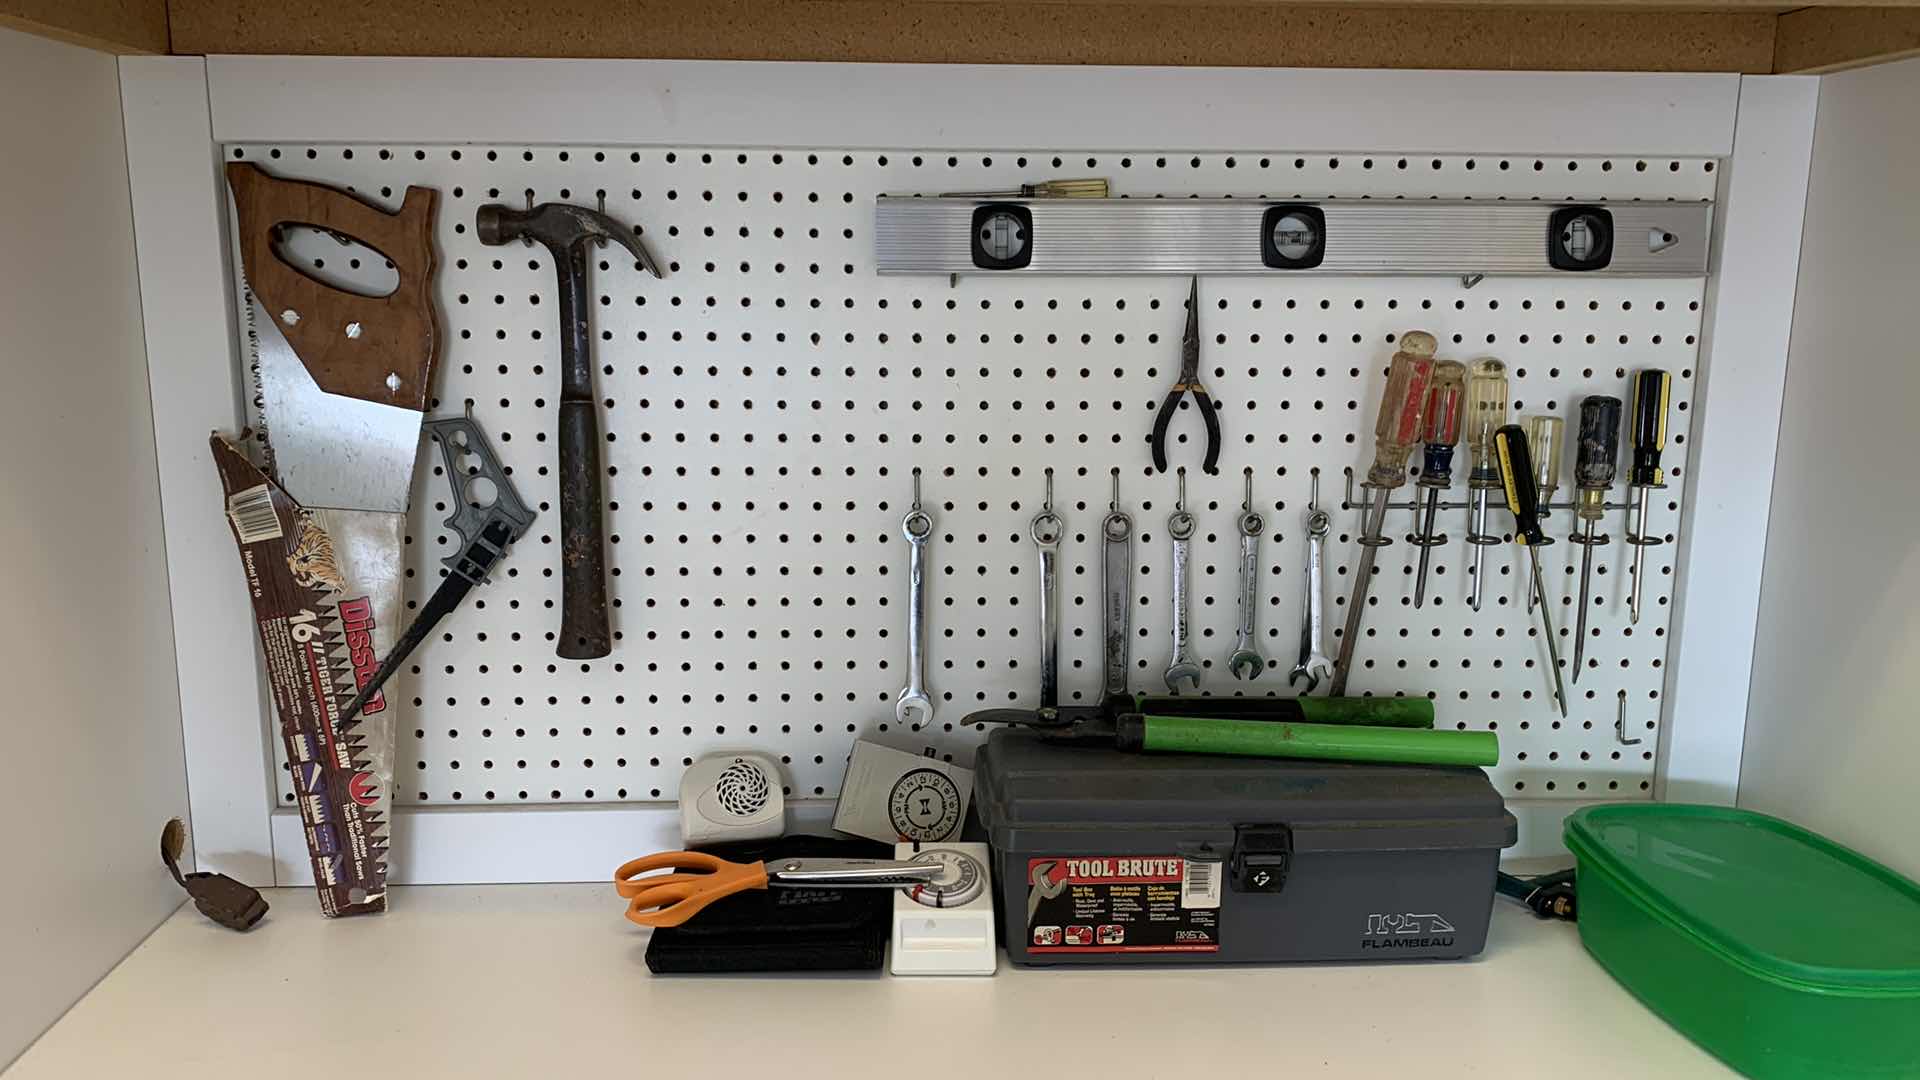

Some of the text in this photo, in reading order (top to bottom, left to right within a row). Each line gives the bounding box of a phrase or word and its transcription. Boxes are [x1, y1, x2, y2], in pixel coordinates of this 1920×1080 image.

[244, 550, 257, 577] Model
[306, 683, 316, 701] Inch
[316, 657, 332, 695] TIGER
[335, 742, 350, 769] SAW
[342, 803, 365, 880] Than Traditional Saws
[349, 801, 359, 818] Cuts
[358, 835, 367, 858] Faster
[1066, 859, 1178, 878] TOOL BRUTE
[1361, 937, 1454, 949] FLAMBEAU
